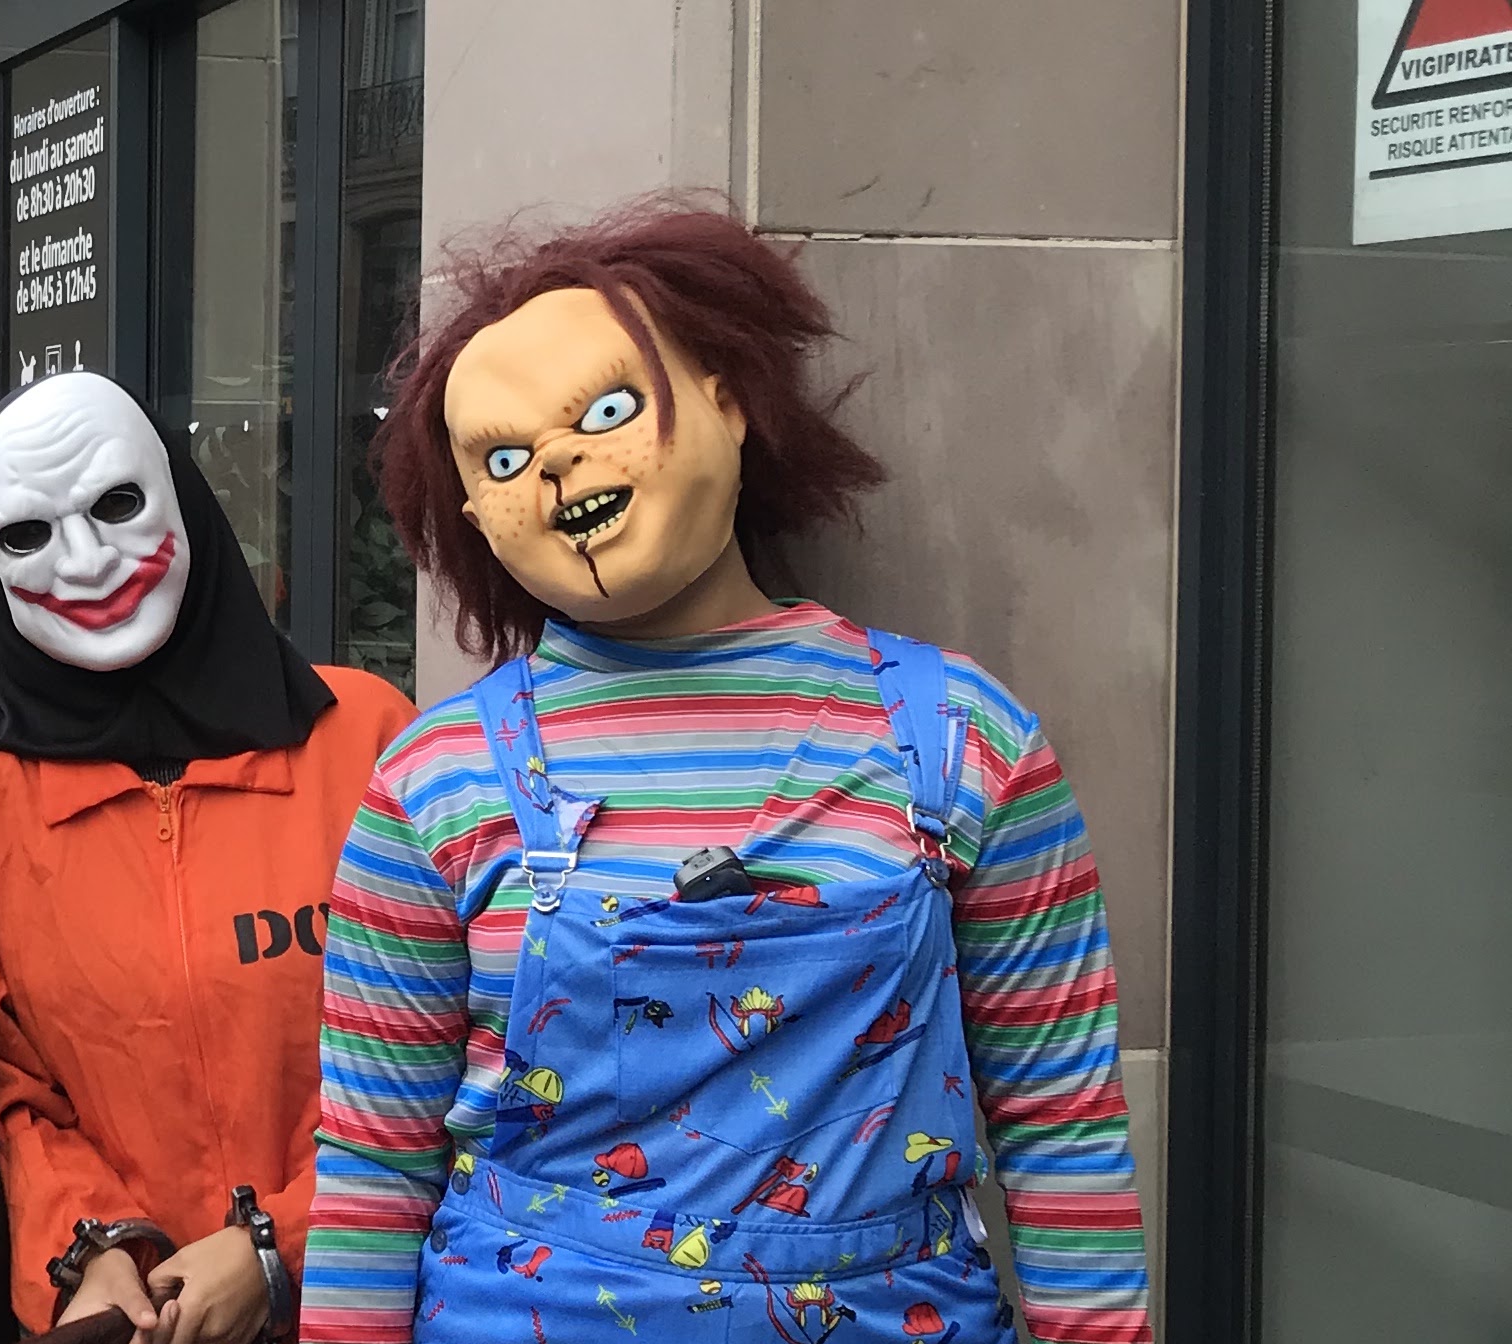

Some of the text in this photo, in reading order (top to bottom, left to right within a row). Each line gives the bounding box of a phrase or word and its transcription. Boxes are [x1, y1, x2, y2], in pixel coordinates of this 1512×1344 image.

[13, 106, 46, 139] Horaires
[47, 87, 95, 125] d'ouverture
[1370, 109, 1444, 137] SECURITE
[10, 116, 104, 184] du lundi au samedi
[1388, 136, 1444, 161] RISQUE
[17, 165, 95, 223] de 8h30 à 20h30
[19, 226, 93, 276] et le dimanche
[16, 265, 96, 314] de 9h45 à 12h45
